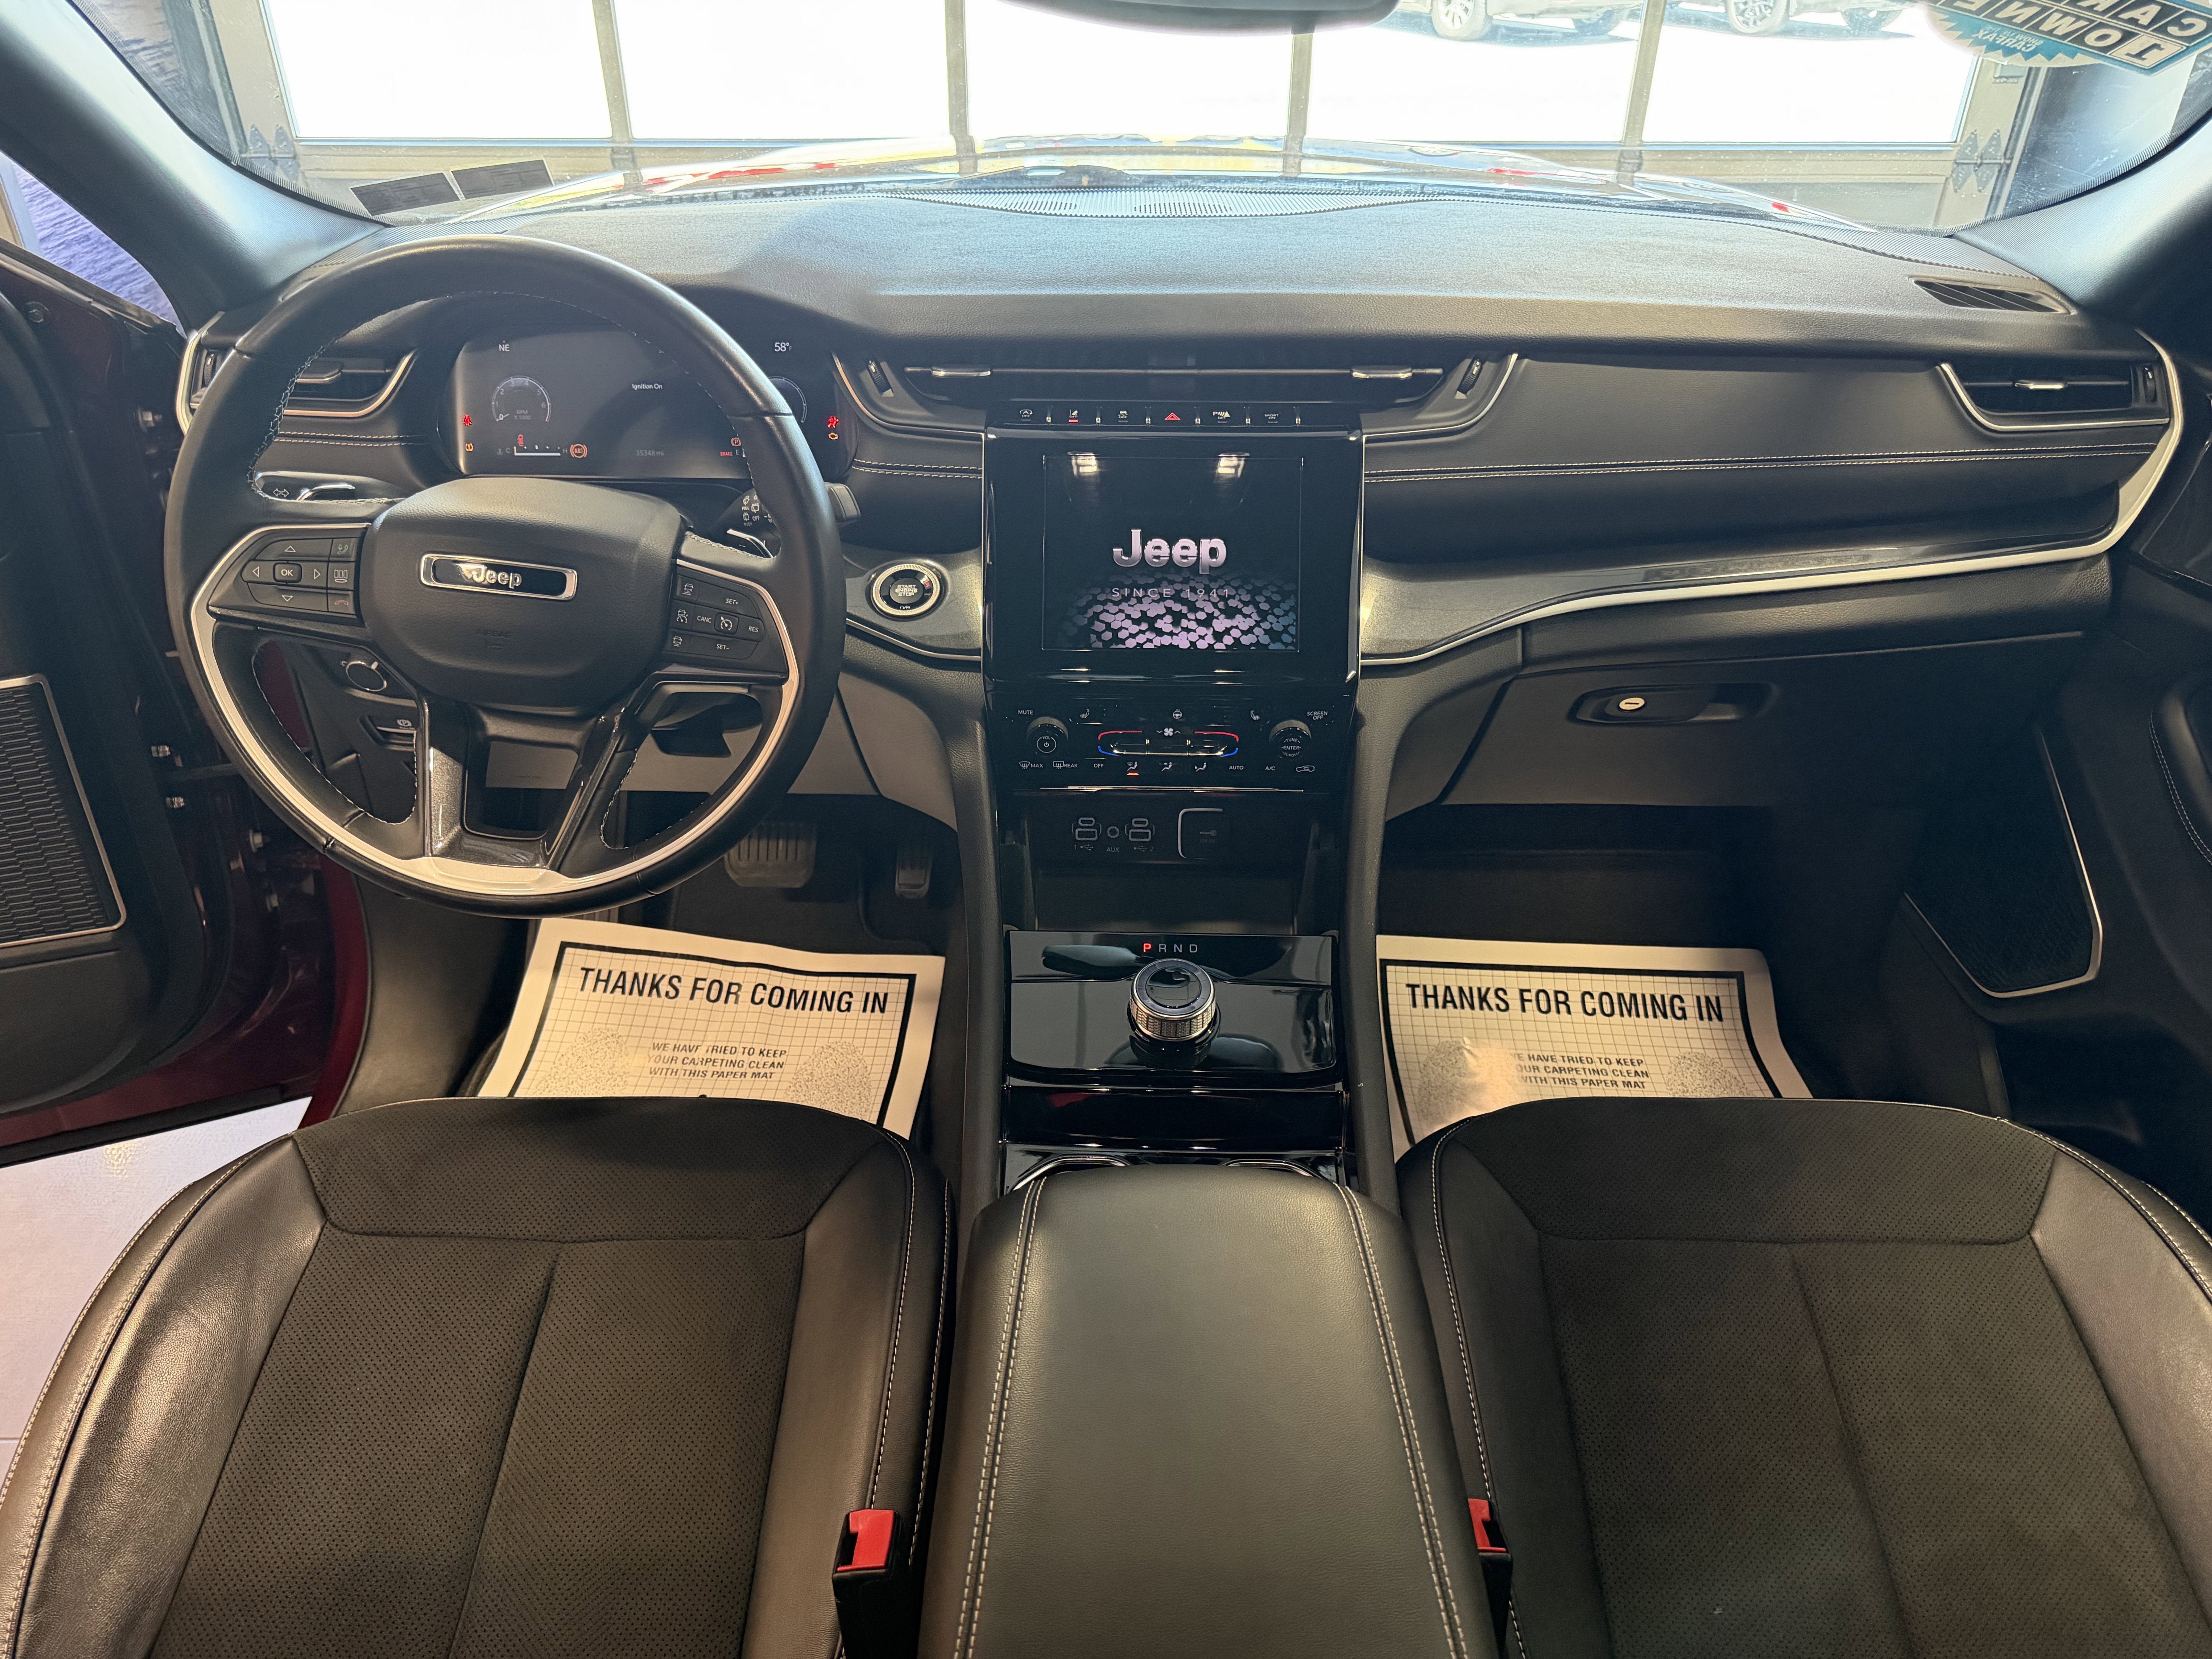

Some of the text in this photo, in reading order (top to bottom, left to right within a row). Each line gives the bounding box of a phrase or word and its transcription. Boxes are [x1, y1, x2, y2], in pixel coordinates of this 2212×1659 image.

[1113, 528, 1227, 574] Jeep
[280, 568, 293, 577] OK
[472, 565, 522, 589] Jeep
[1112, 587, 1230, 598] SINCE 1941
[697, 615, 712, 623] CANC
[1143, 943, 1198, 953] P R N D
[580, 967, 888, 1014] THANKS FOR COMING IN
[1406, 983, 1724, 1022] THANKS FOR COMING IN
[653, 1042, 670, 1052] WE
[705, 1045, 737, 1055] TRIED
[742, 1046, 755, 1056] TO
[759, 1048, 787, 1058] KEEP
[647, 1054, 785, 1069] YOUR CARPETING CLEAN
[1527, 1053, 1557, 1063] HAVE
[1561, 1055, 1594, 1064] TRIED
[1596, 1057, 1612, 1066] TO
[1615, 1058, 1644, 1067] KEEP
[649, 1067, 775, 1079] WITH THIS PAPER MAT
[1515, 1063, 1650, 1079] OUR CARPETING CLEAN
[1550, 1077, 1578, 1087] THIS
[1581, 1078, 1619, 1088] PAPER
[1622, 1080, 1646, 1089] MAT
